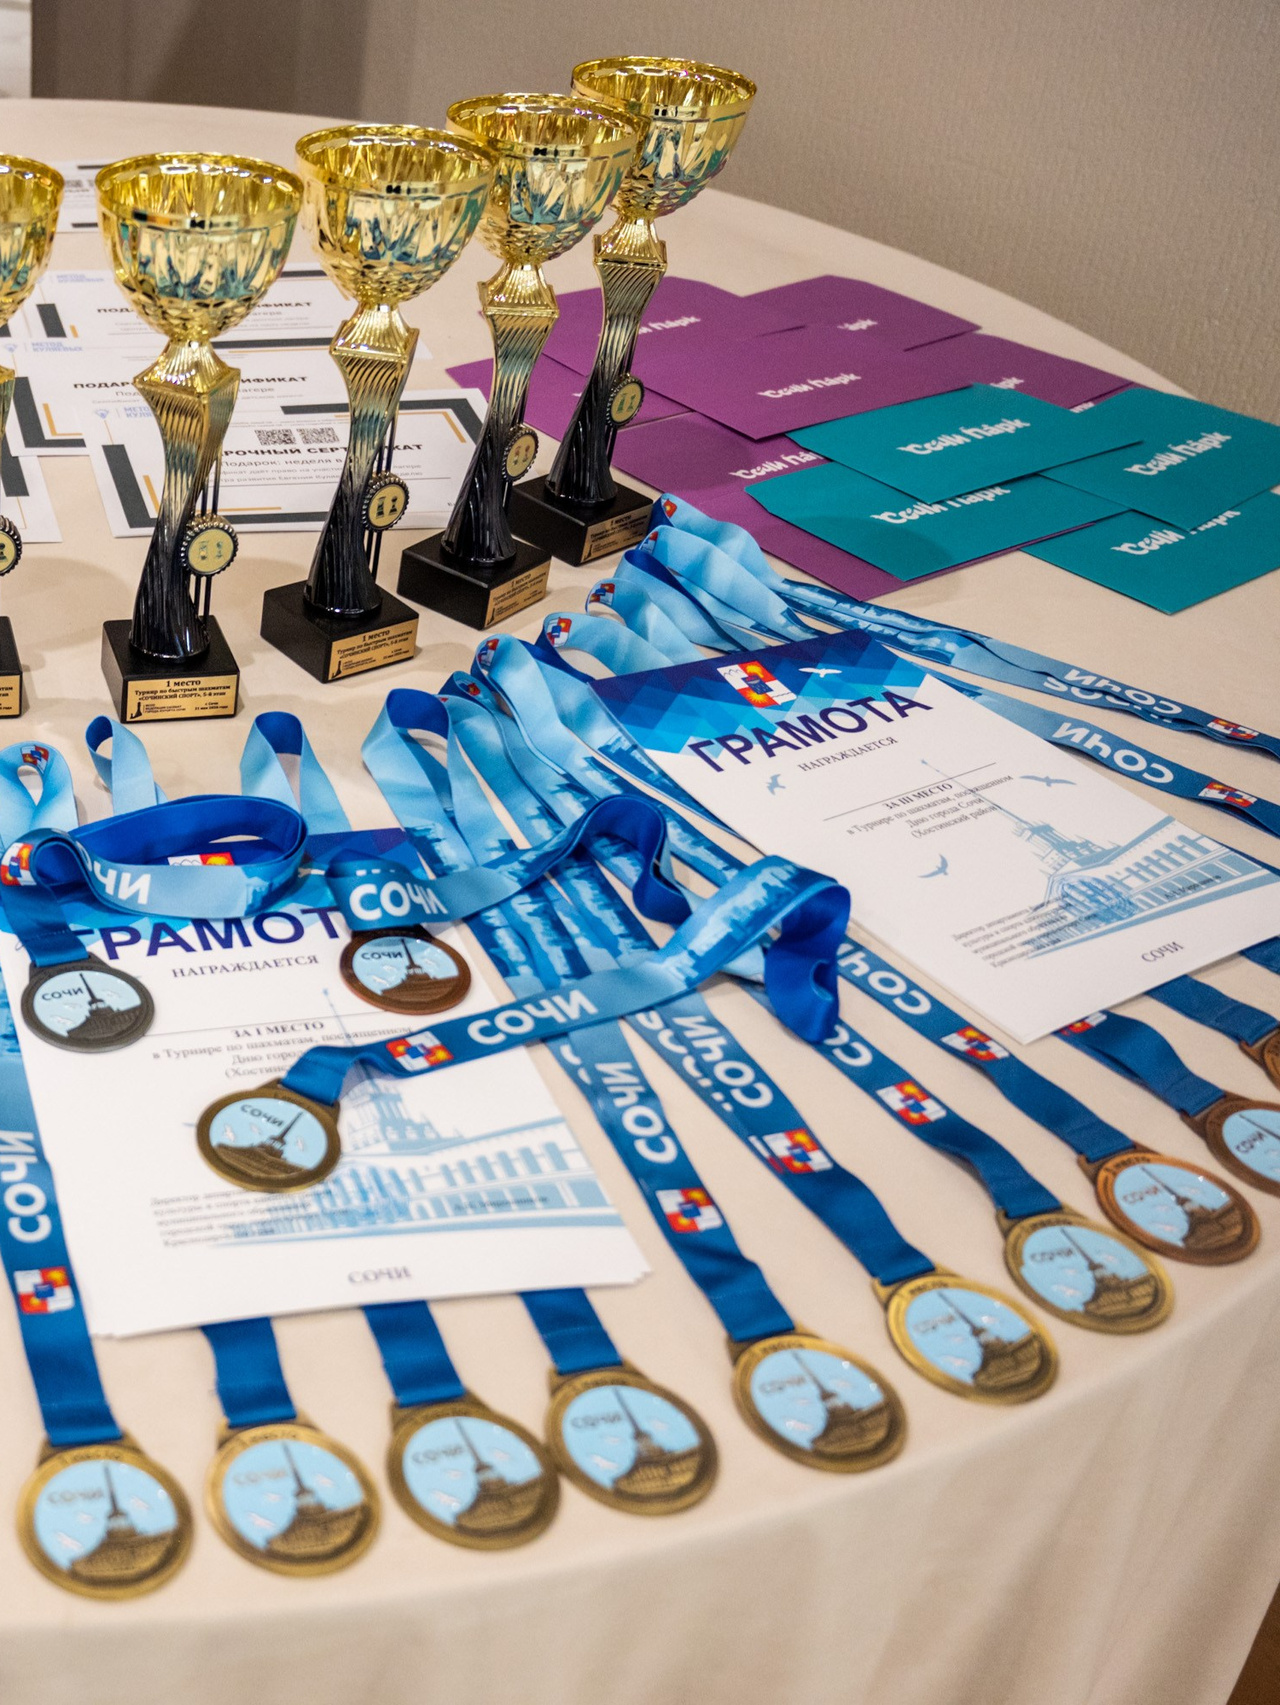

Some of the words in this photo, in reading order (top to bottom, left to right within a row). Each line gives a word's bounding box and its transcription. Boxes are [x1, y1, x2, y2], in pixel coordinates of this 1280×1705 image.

[687, 690, 934, 773] ГРАМОТА
[797, 736, 899, 773] НАГРАЖДАЕТСЯ
[1051, 722, 1175, 784] СОЧИ
[912, 782, 953, 801] МЕСТО
[349, 881, 448, 921] СОЧИ
[361, 949, 403, 962] СОЧИ
[1141, 941, 1185, 963] СОЧИ
[172, 955, 320, 978] НАГРАЖДАЕТСЯ
[41, 986, 83, 1001] СОЧИ
[264, 1021, 325, 1037] МЕСТО
[467, 989, 599, 1045] СОЧИ
[671, 1015, 774, 1109] СОЧИ
[239, 1103, 282, 1127] СОЧИ
[593, 1061, 679, 1164] СОЧИ
[347, 1266, 413, 1285] СОЧИ
